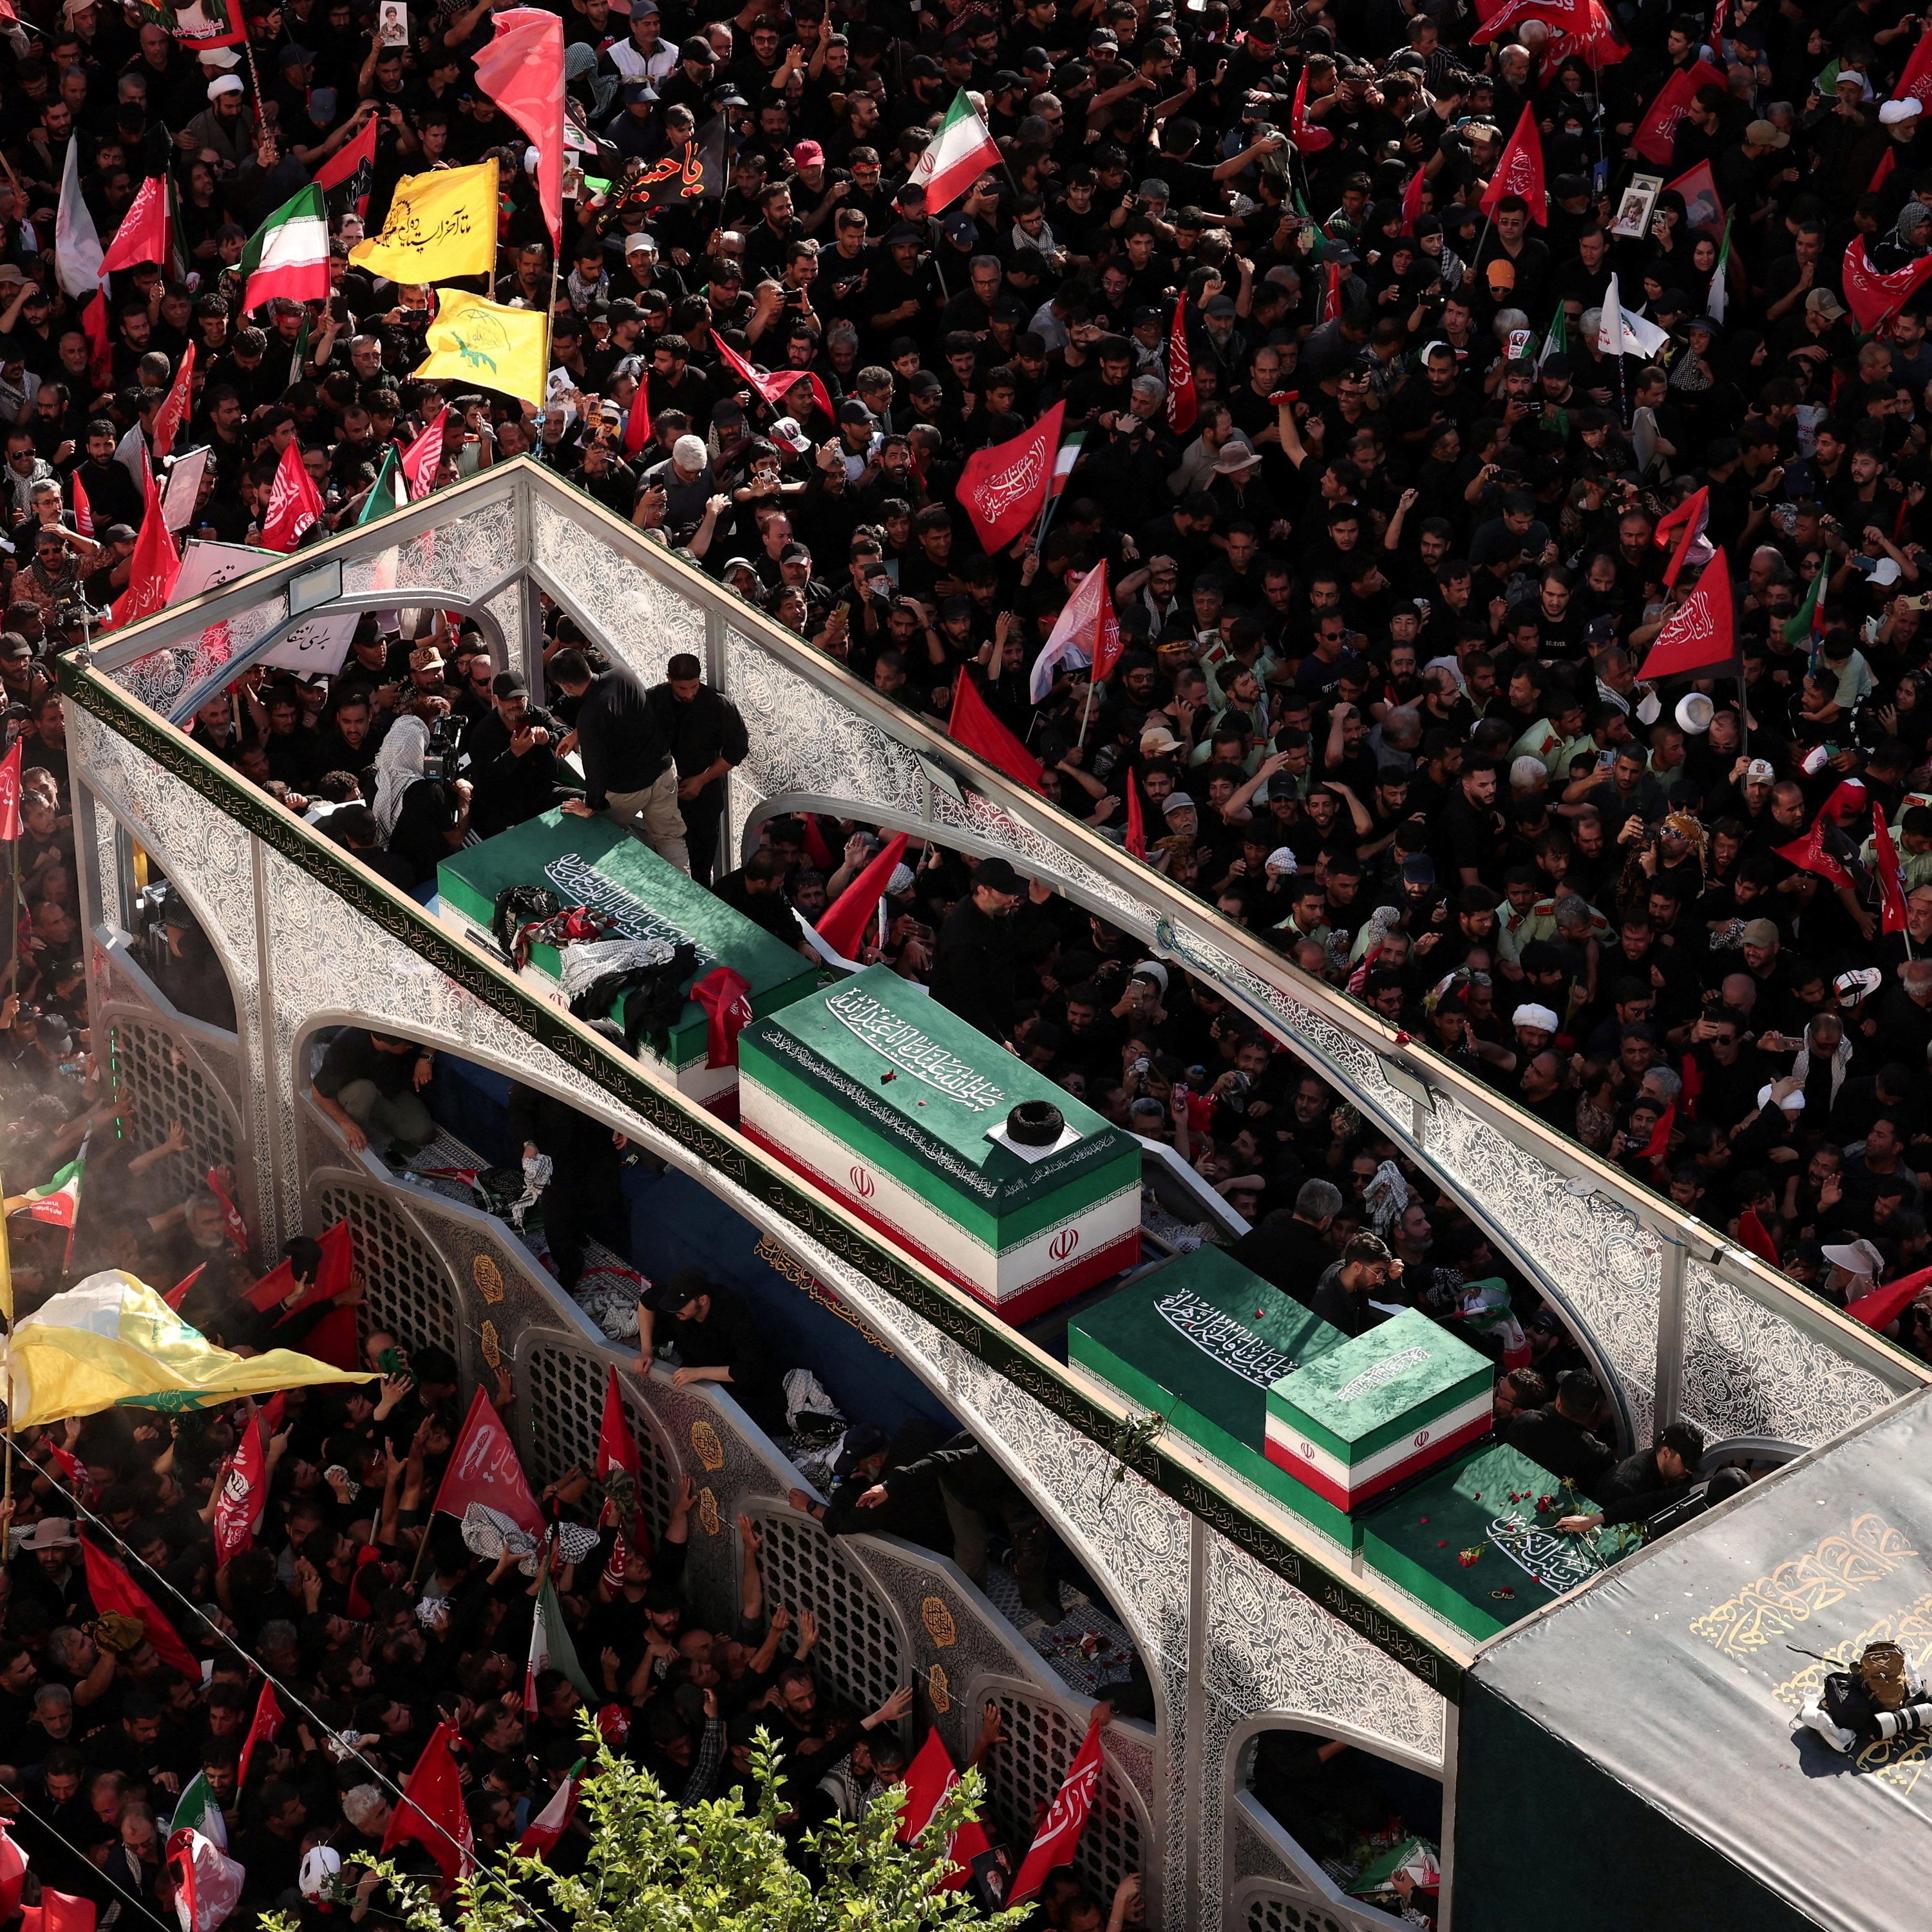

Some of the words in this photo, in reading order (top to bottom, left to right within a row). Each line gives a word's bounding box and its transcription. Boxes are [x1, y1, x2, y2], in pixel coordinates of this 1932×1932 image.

[438, 205, 466, 246] آخر
[287, 624, 315, 643] انتقا
[552, 1035, 597, 1076] العالمين
[706, 1139, 746, 1183] السلام
[952, 1317, 982, 1352] السلام
[1264, 1540, 1300, 1582] السلام
[1401, 1640, 1437, 1680] السلام
